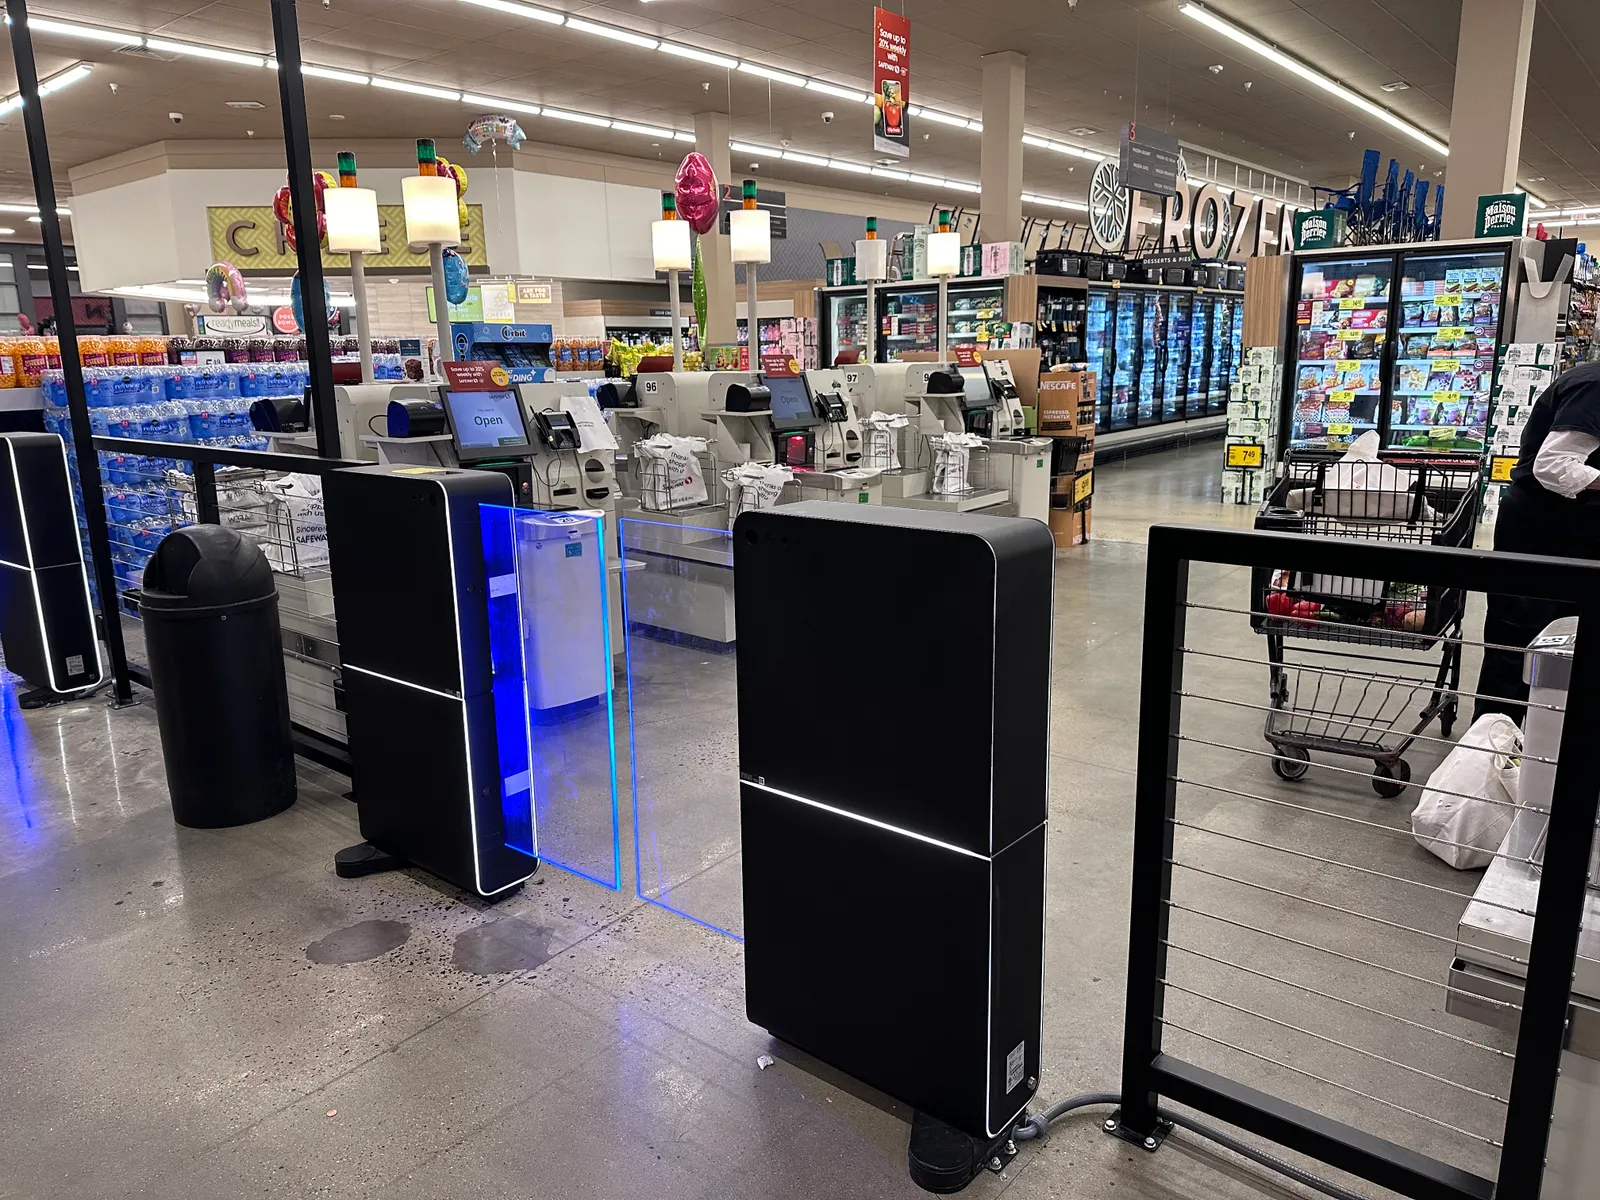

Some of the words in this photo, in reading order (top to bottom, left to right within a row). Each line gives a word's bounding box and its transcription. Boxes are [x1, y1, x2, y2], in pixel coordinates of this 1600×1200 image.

[880, 28, 893, 40] Save
[892, 33, 899, 44] up
[900, 36, 906, 44] to
[878, 38, 889, 50] 20%
[889, 43, 907, 56] weekly
[887, 52, 898, 62] with
[1129, 121, 1136, 141] 3
[723, 184, 731, 200] 2
[1485, 202, 1516, 218] Maison
[1301, 217, 1327, 230] Maison
[847, 374, 857, 383] 97
[646, 382, 657, 392] 96
[781, 396, 799, 404] Open
[474, 416, 503, 428] Open
